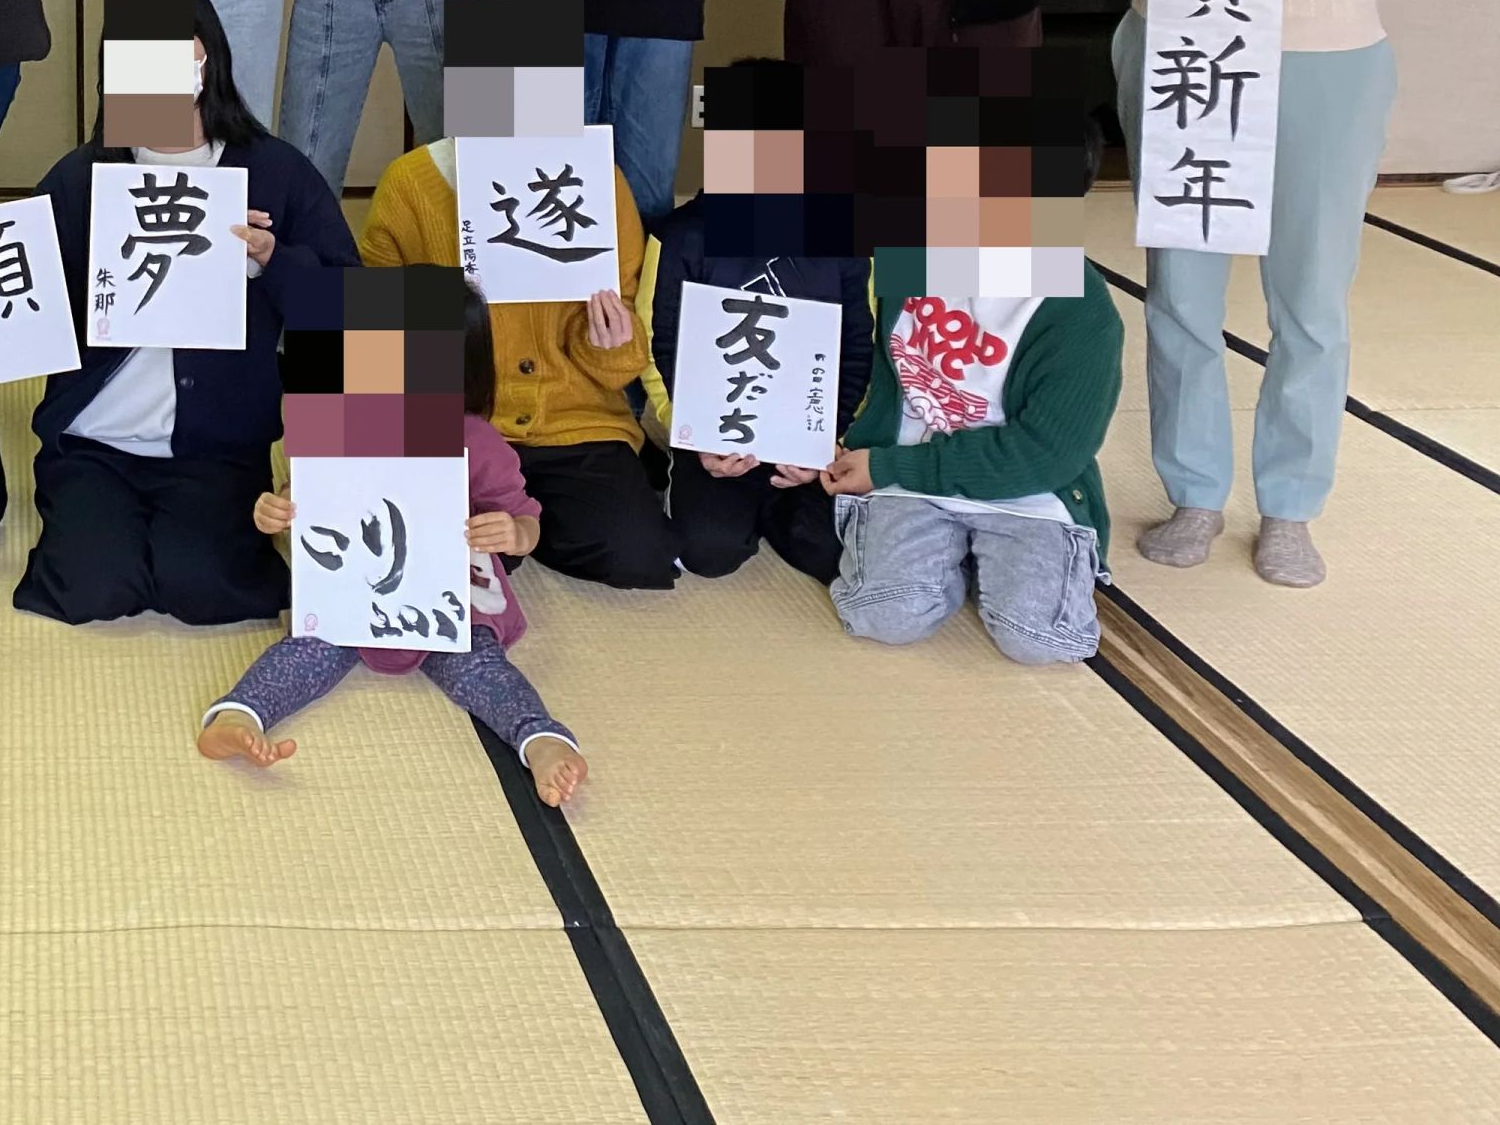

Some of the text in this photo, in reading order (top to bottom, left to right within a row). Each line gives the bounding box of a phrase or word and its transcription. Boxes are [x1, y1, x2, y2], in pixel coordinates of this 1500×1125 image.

[120, 171, 213, 316] 夢
[486, 163, 615, 263] 遂
[715, 295, 790, 445] 友だち
